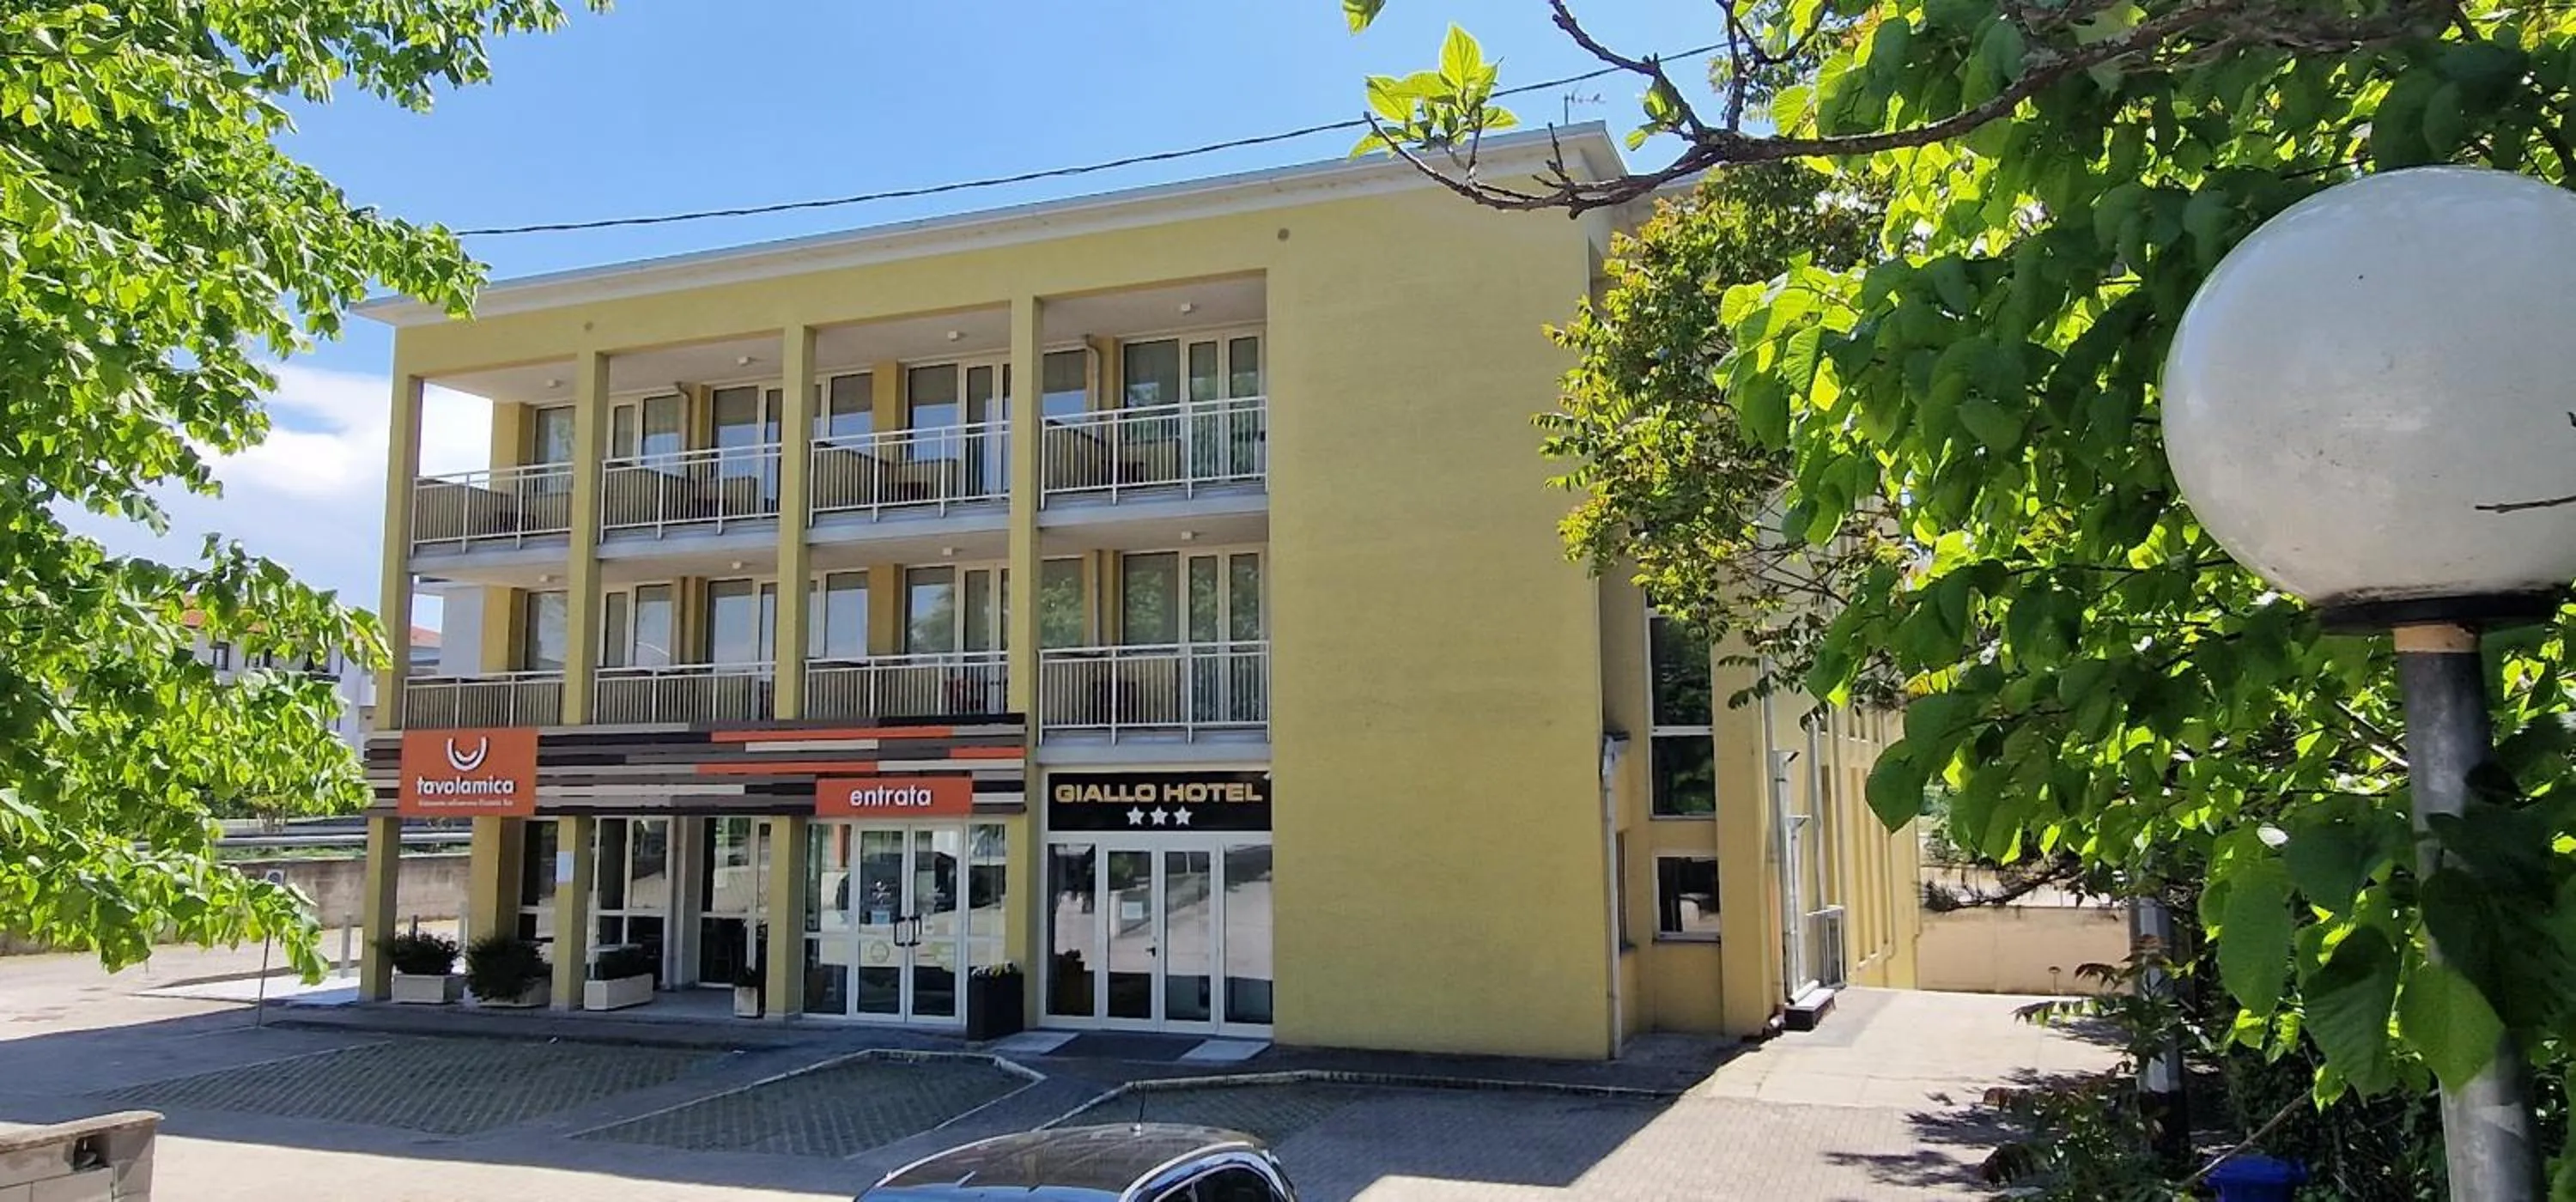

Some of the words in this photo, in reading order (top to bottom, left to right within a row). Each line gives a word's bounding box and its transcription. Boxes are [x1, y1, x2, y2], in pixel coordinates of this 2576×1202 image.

[416, 775, 514, 794] tavolamica
[850, 784, 933, 806] entrata
[1054, 783, 1157, 804] GIALLO
[1163, 782, 1264, 803] HOTEL
